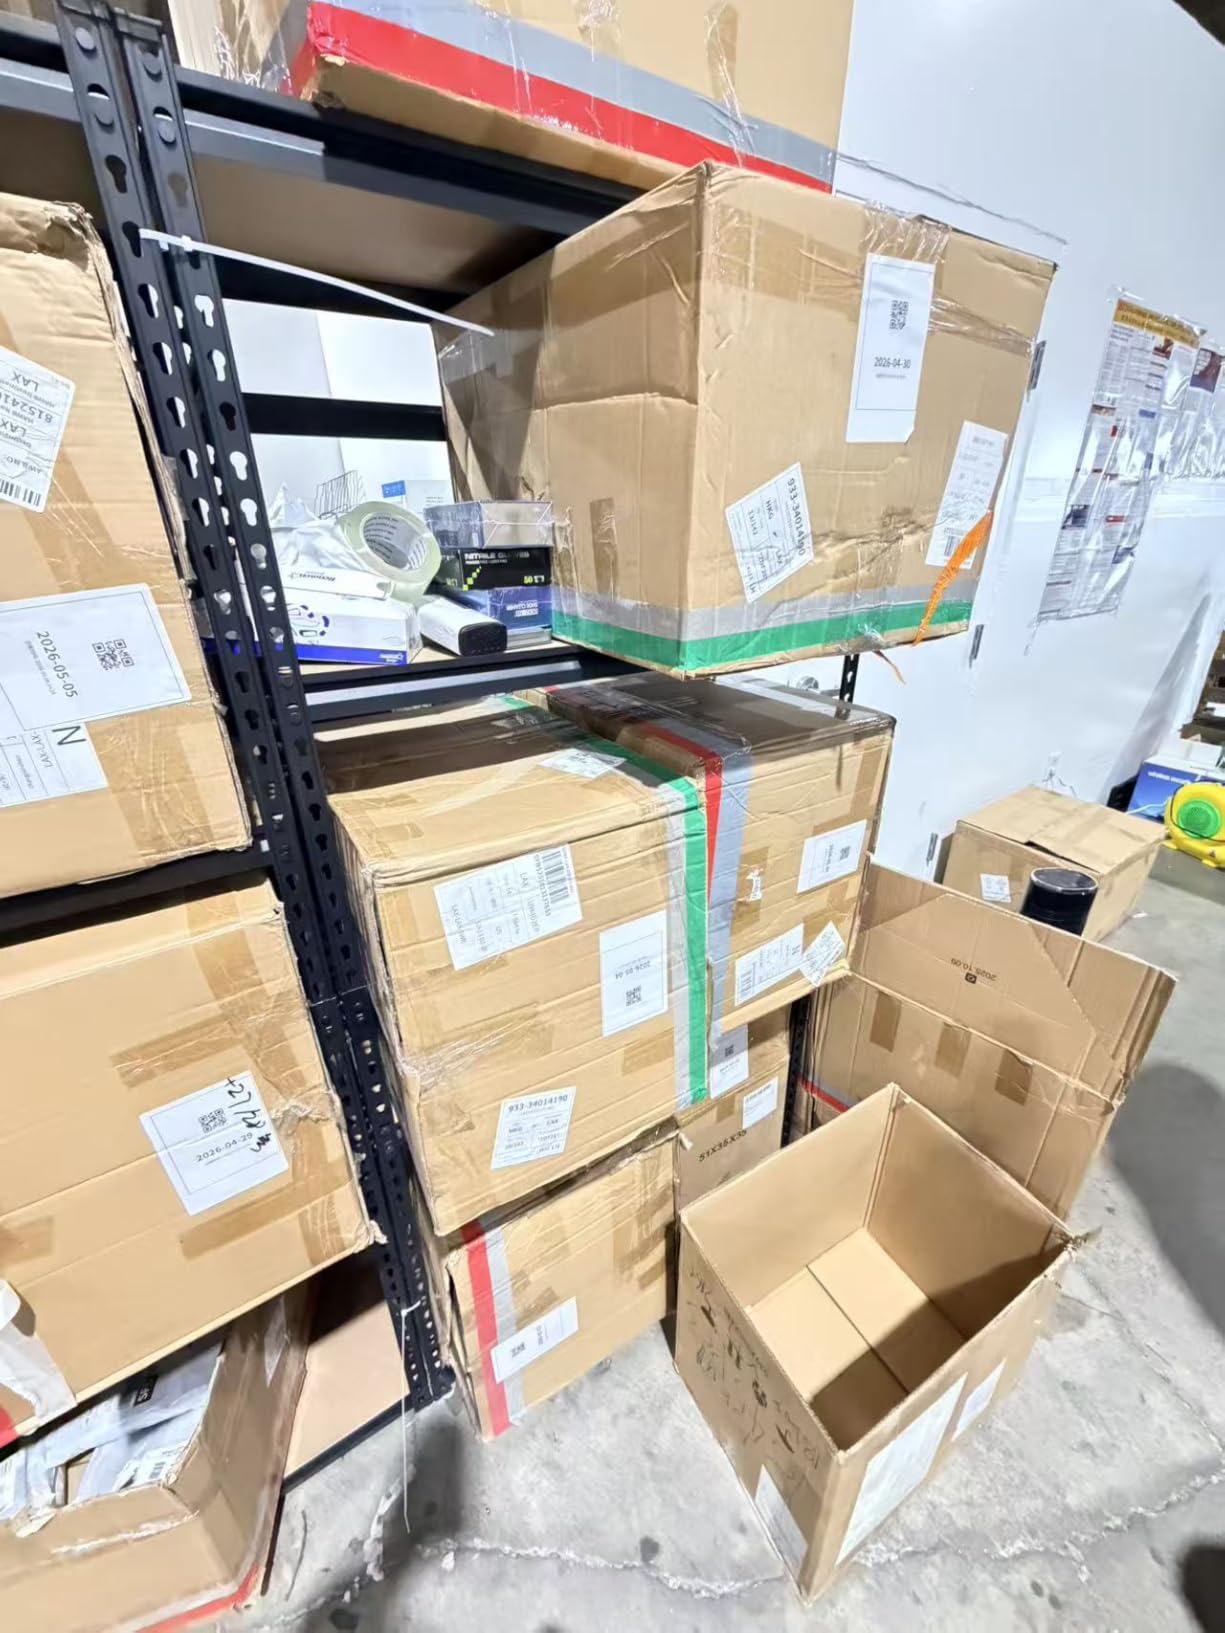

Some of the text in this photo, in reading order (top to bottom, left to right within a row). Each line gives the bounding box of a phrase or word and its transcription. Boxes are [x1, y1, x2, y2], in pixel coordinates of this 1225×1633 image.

[12, 371, 39, 392] LAX
[0, 418, 27, 438] LAX
[37, 631, 78, 698] 2026-05-05
[52, 725, 87, 746] N
